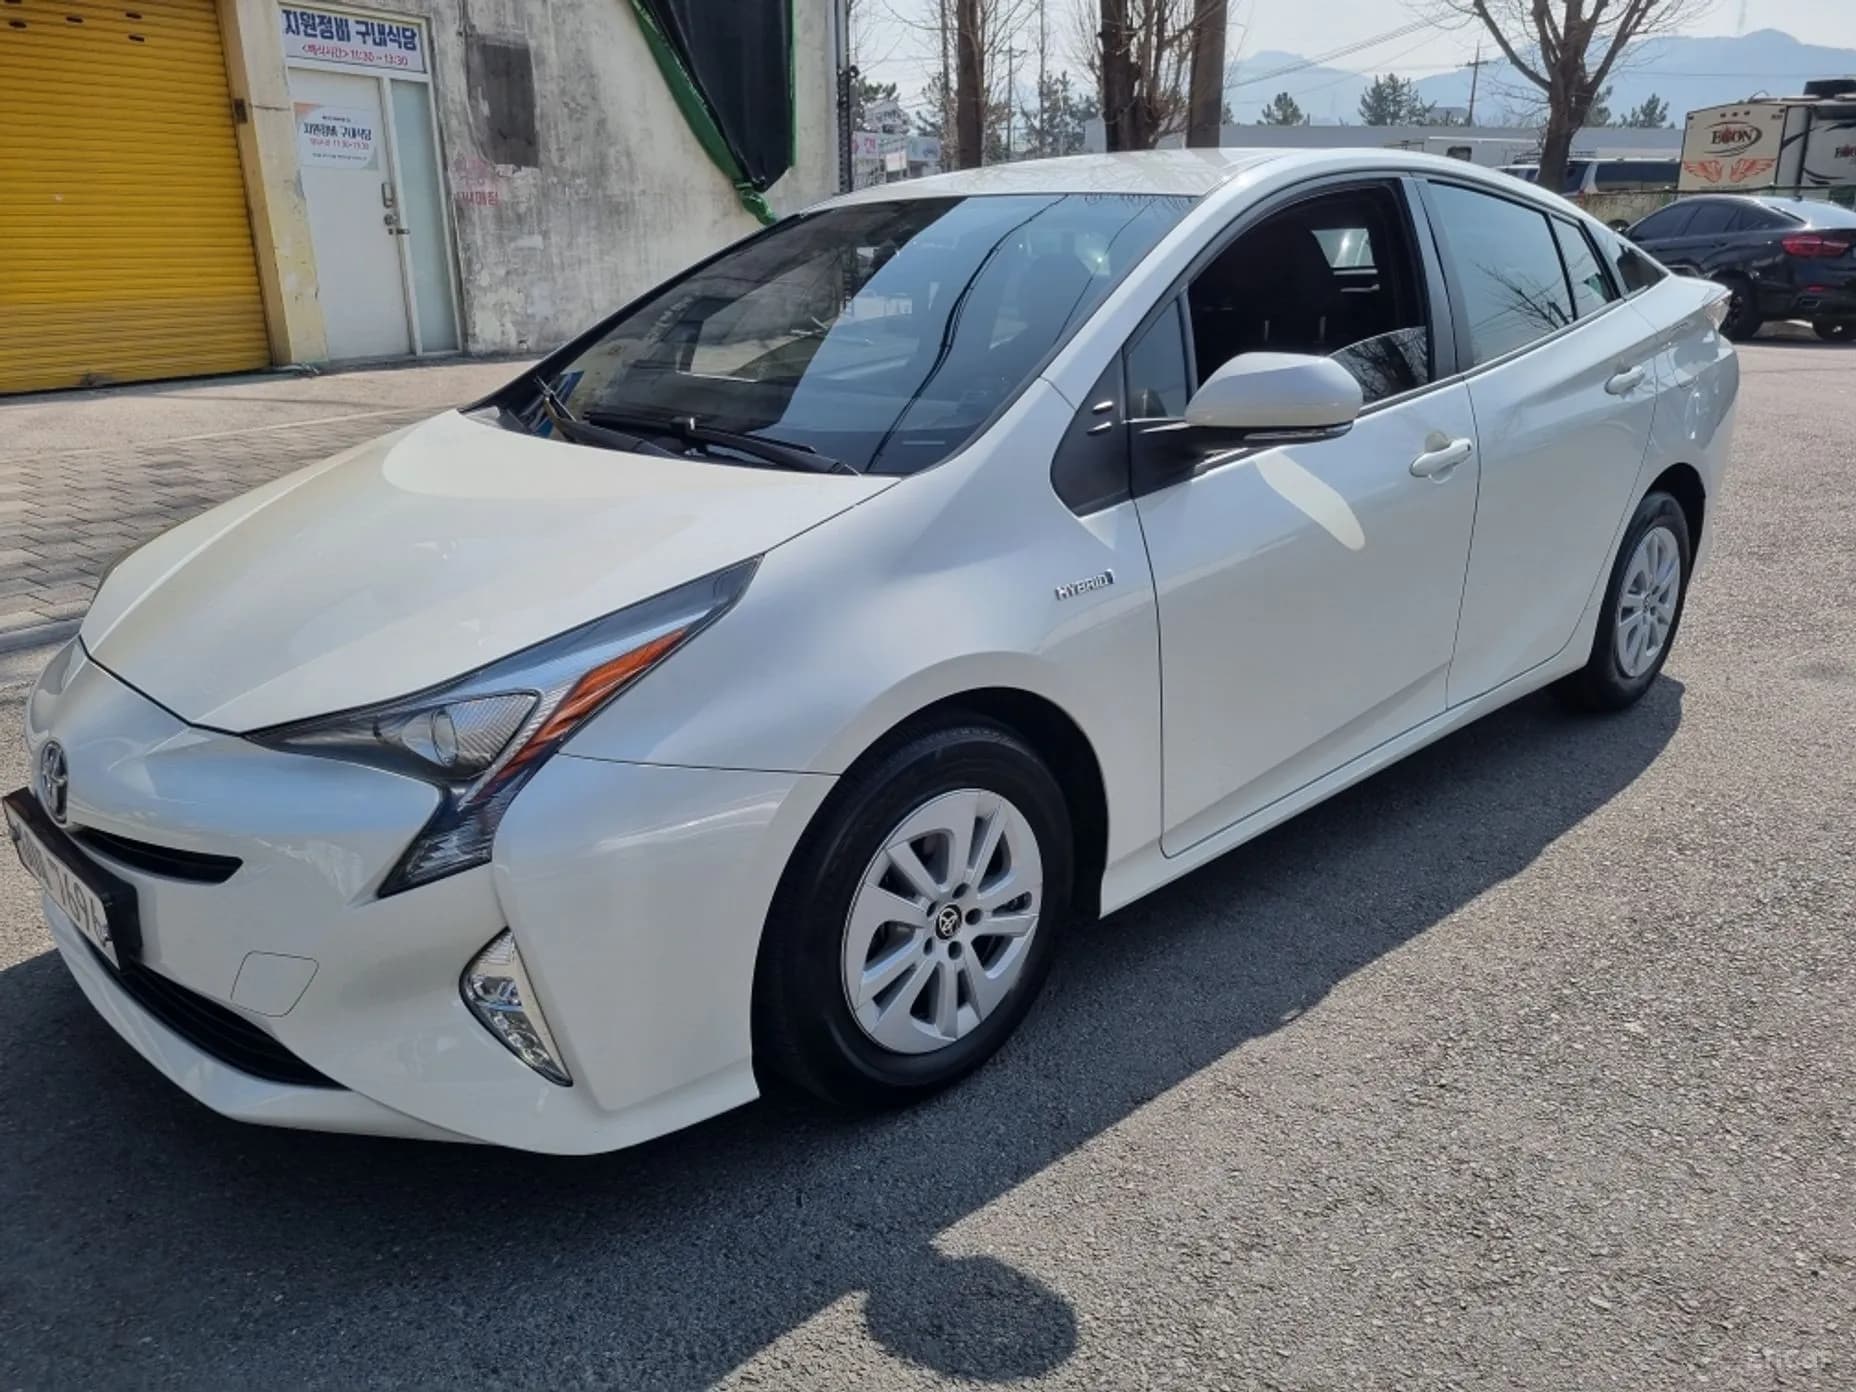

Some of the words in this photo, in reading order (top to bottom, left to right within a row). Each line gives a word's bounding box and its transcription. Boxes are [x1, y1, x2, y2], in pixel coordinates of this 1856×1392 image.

[281, 9, 351, 42] 지원정비
[354, 20, 417, 51] 구내식당
[350, 49, 375, 63] 11:30
[384, 53, 408, 67] 13:30
[340, 125, 372, 142] 구내식당
[1055, 571, 1110, 601] HYBRID
